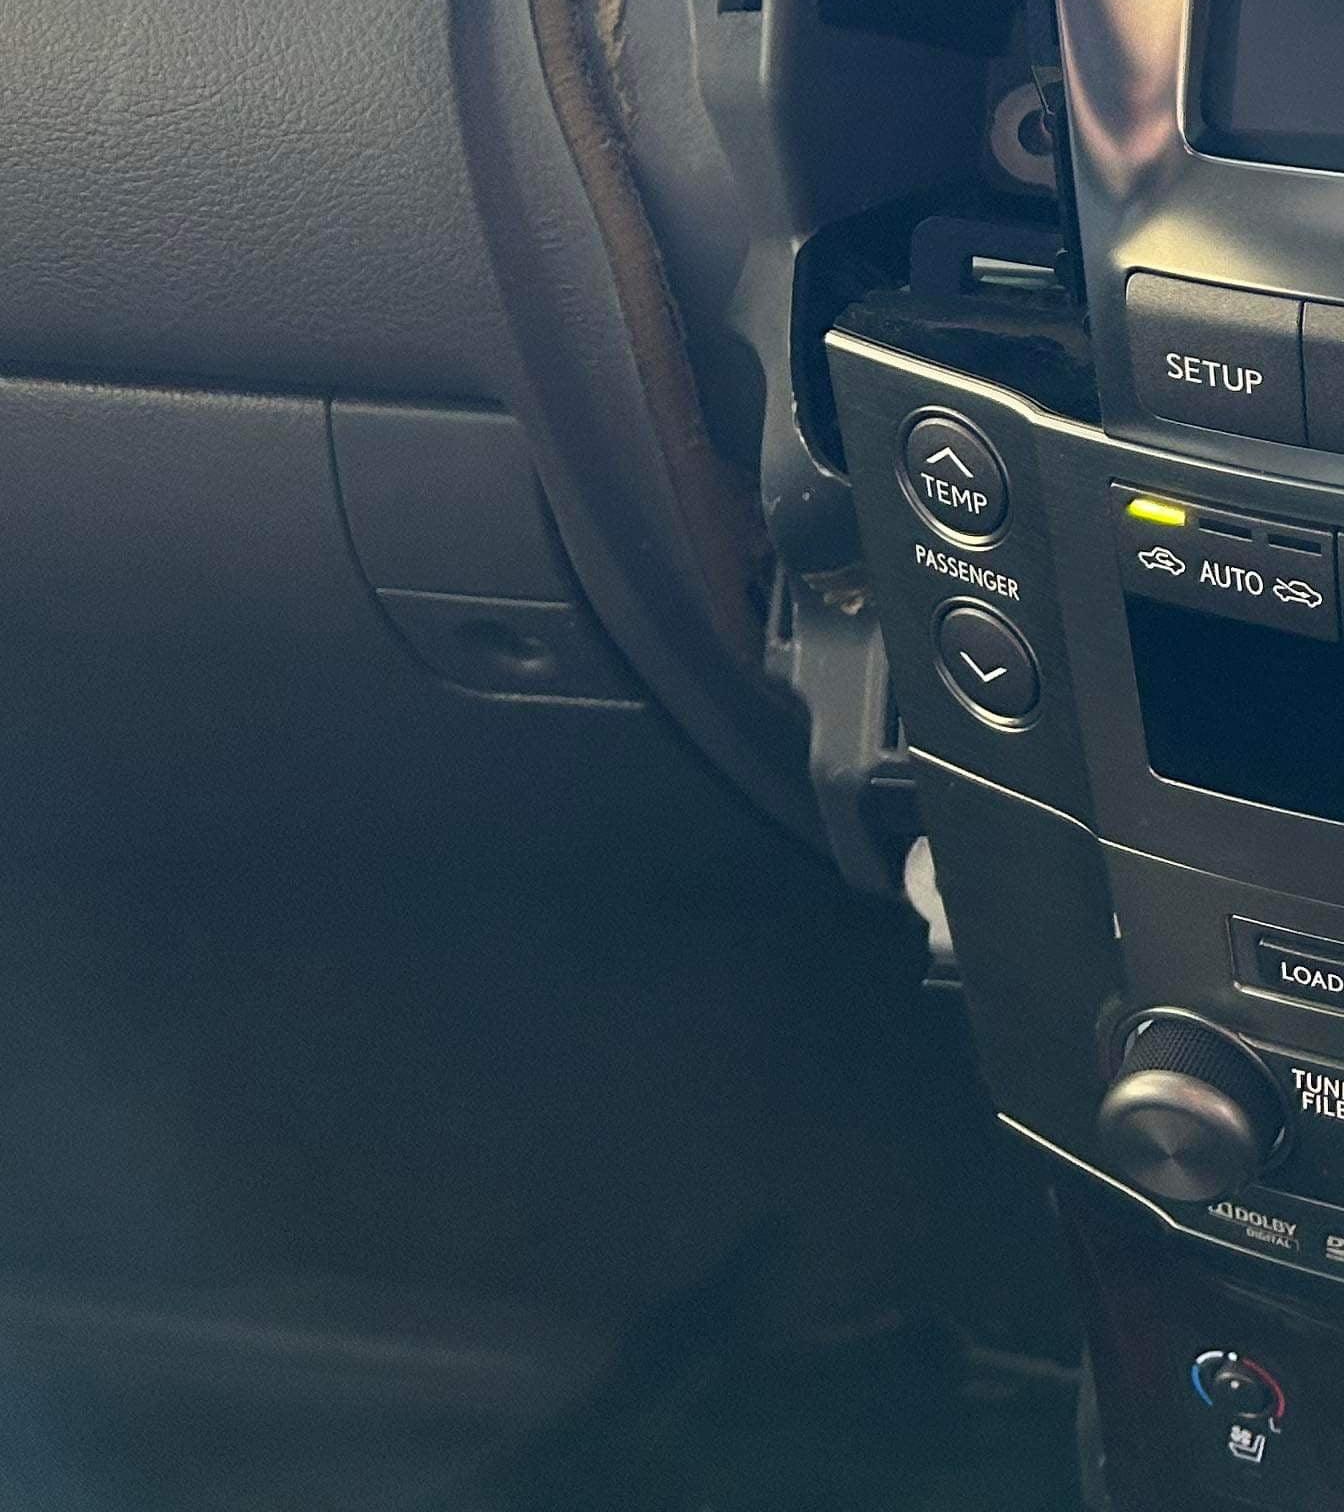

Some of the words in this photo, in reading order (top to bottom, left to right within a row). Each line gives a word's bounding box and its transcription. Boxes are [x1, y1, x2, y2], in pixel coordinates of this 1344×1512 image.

[1166, 353, 1264, 394] SETUP
[921, 473, 988, 514] TEMP
[916, 544, 1020, 600] PASSENGER
[1200, 560, 1264, 597] AUTO
[1281, 960, 1344, 994] LOAD
[1235, 1207, 1297, 1236] DOLBY
